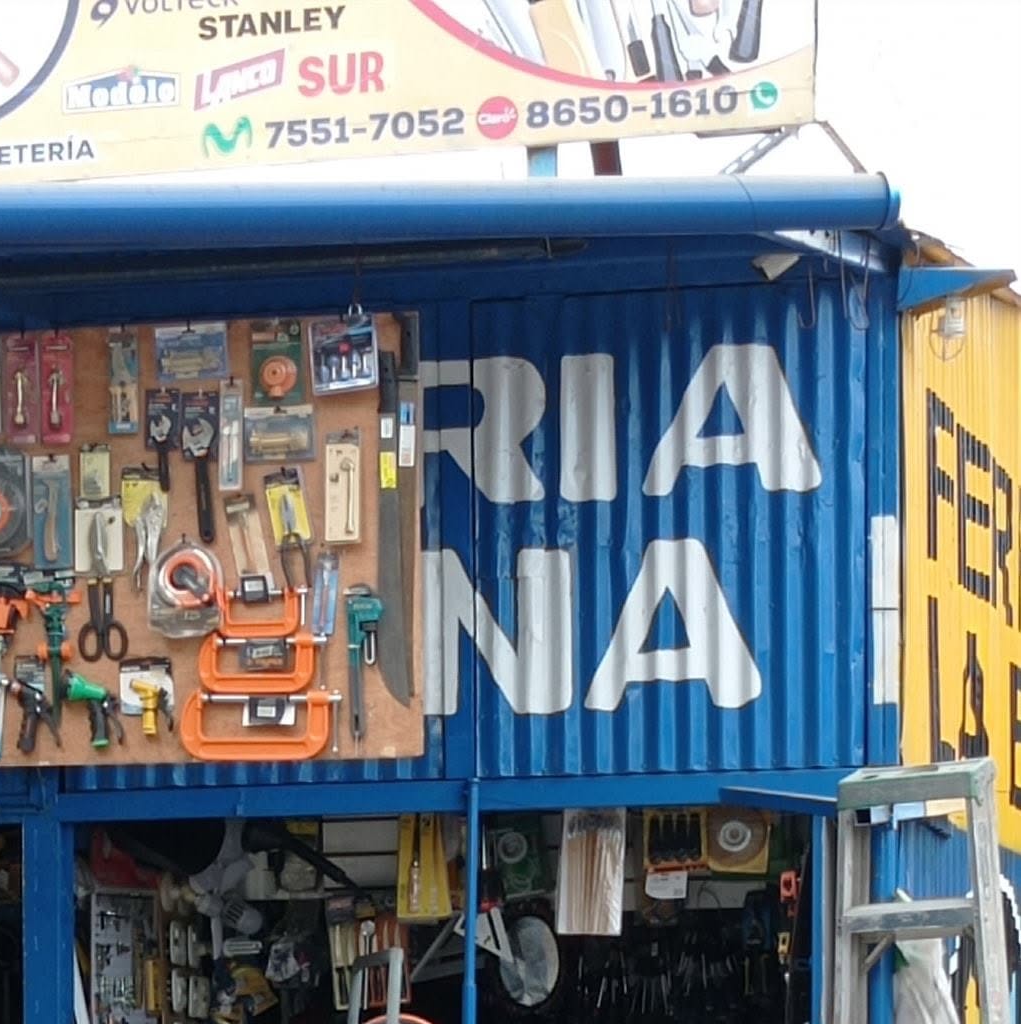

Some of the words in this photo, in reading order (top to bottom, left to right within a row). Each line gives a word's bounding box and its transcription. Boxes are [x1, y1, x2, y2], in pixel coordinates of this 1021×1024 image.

[198, 5, 345, 40] STANLEY
[298, 51, 385, 98] SUR
[265, 108, 464, 149] 7551-7052
[526, 85, 738, 129] 8650-1610
